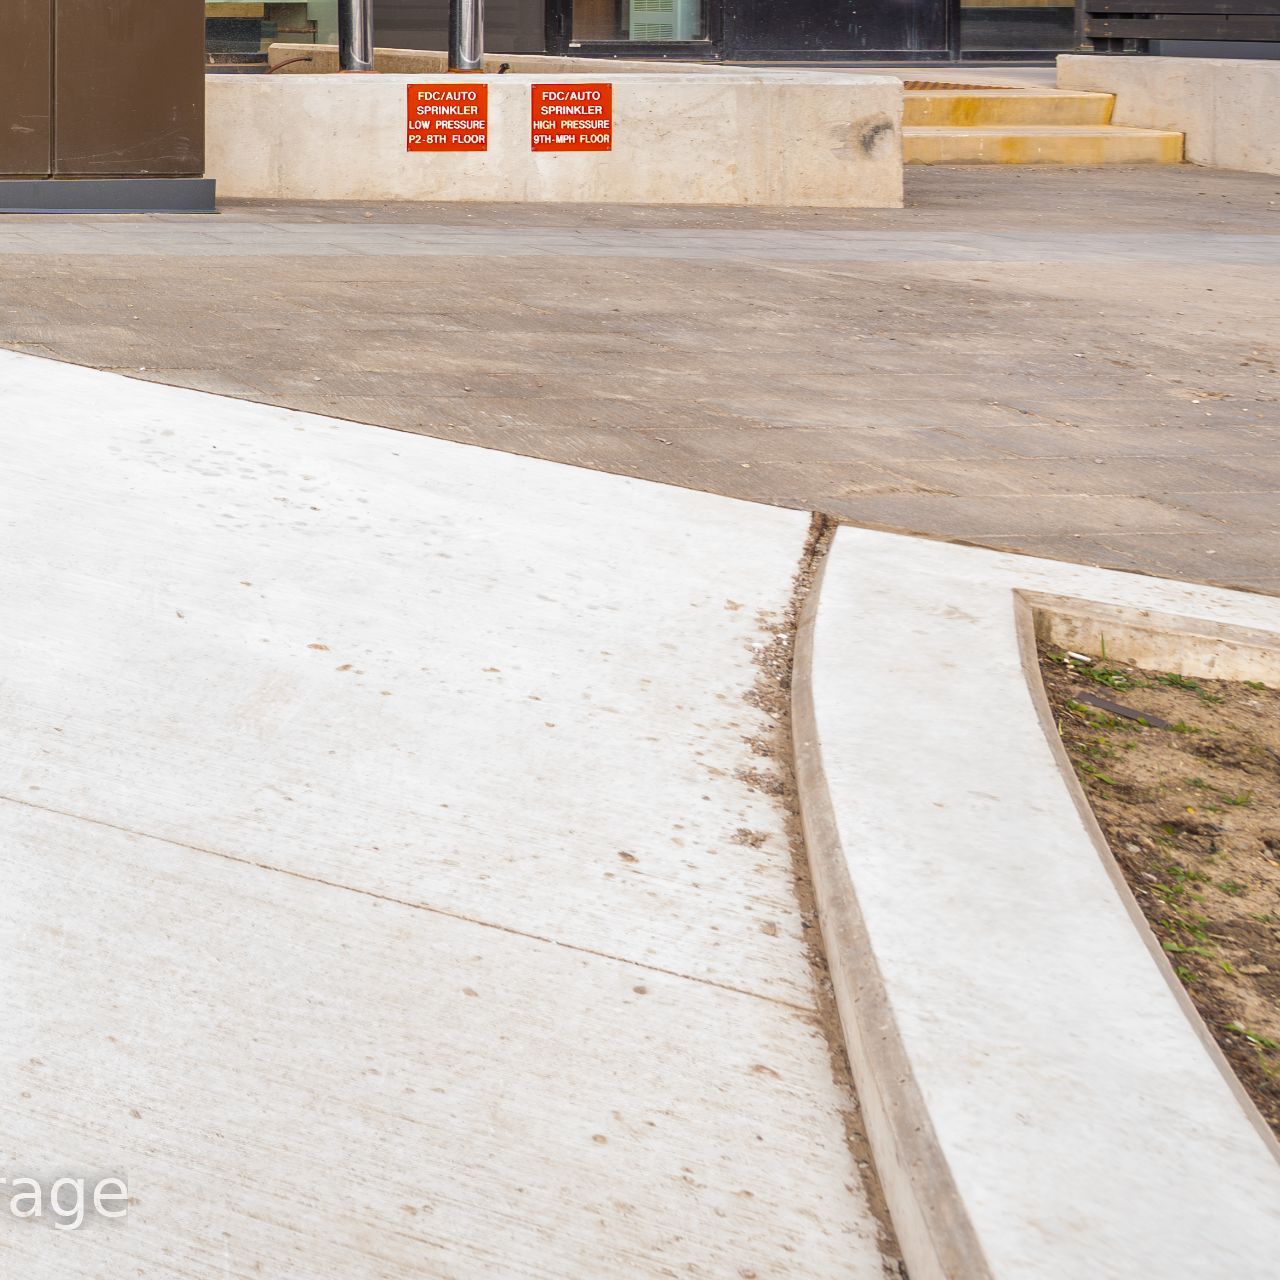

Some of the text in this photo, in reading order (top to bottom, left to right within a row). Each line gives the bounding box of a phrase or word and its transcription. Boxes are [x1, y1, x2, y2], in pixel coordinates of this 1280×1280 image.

[417, 91, 477, 101] FDC/AUTO
[542, 91, 601, 101] FDC/AUTO
[416, 105, 478, 115] SPRINKLER
[540, 105, 603, 115] SPRINKLER
[408, 120, 486, 130] LOW PRESSURE
[533, 119, 610, 130] HIGH PRESSURE
[408, 134, 486, 144] P2-8TH FLOOR
[533, 133, 610, 144] 9TH-MPH FLOOR
